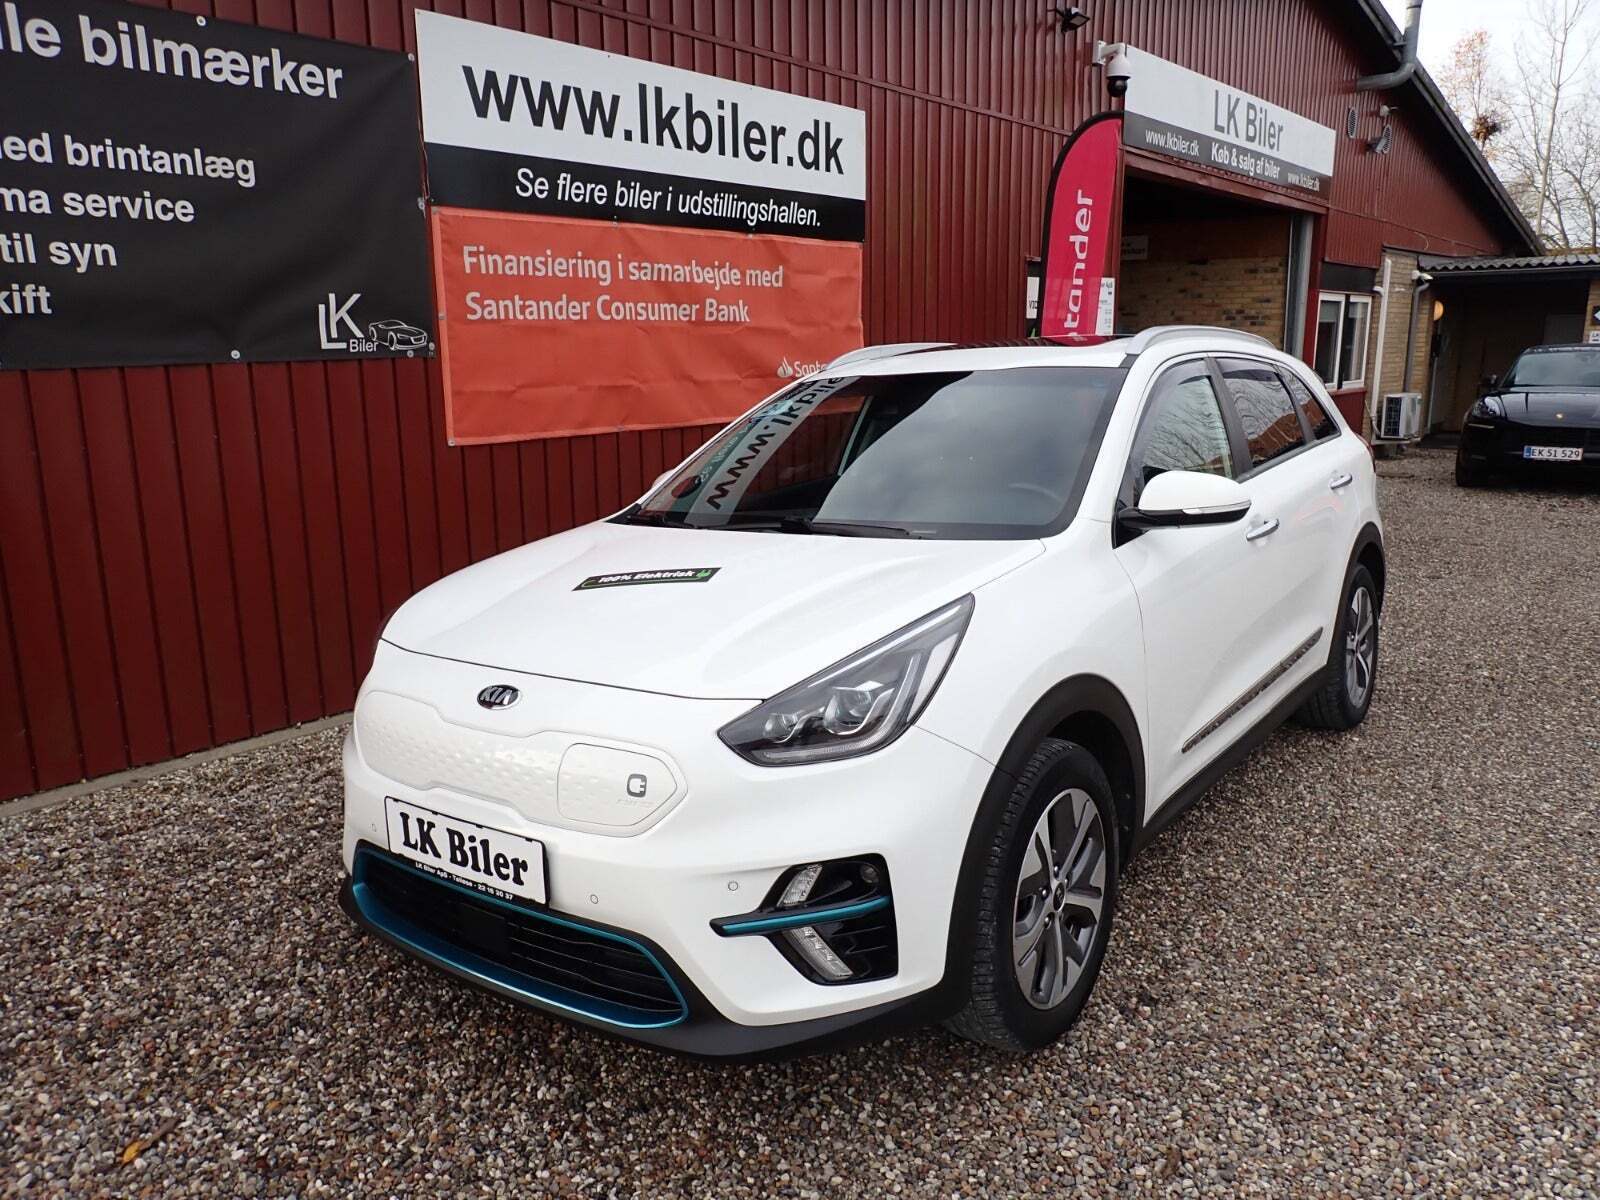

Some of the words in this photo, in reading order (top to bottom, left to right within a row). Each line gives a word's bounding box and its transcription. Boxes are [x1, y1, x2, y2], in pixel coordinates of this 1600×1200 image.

[0, 2, 61, 58] le
[79, 14, 343, 99] bilmærker
[462, 65, 845, 175] www.lkbiler.dk
[1213, 89, 1241, 139] LK
[1245, 102, 1283, 151] Biler
[0, 133, 53, 164] ed
[64, 134, 256, 188] brintanlæg
[1145, 129, 1200, 157] www.lkbiler.dk
[1211, 142, 1230, 163] Køb
[1231, 148, 1238, 168] &
[1239, 153, 1254, 176] salg
[1256, 159, 1264, 174] af
[1264, 161, 1281, 179] biler
[63, 191, 195, 223] service
[515, 167, 549, 199] Se
[556, 173, 608, 205] flere
[615, 181, 661, 212] biler
[666, 186, 672, 212] i
[677, 193, 821, 228] udstillingshallen.
[49, 240, 118, 273] syn
[463, 246, 611, 285] Finansiering
[617, 253, 624, 280] i
[628, 259, 741, 290] samarbejde
[745, 265, 783, 288] med
[318, 293, 365, 350] LK
[349, 339, 379, 353] Biler
[466, 292, 590, 322] Santander
[597, 295, 698, 322] Consumer
[704, 299, 750, 323] Bank
[1531, 448, 1544, 457] EK
[1547, 449, 1557, 458] 51
[1561, 450, 1580, 459] 529
[598, 574, 632, 583] 100%
[480, 686, 513, 705] KIA
[400, 812, 442, 859] LK
[446, 827, 528, 886] Biler
